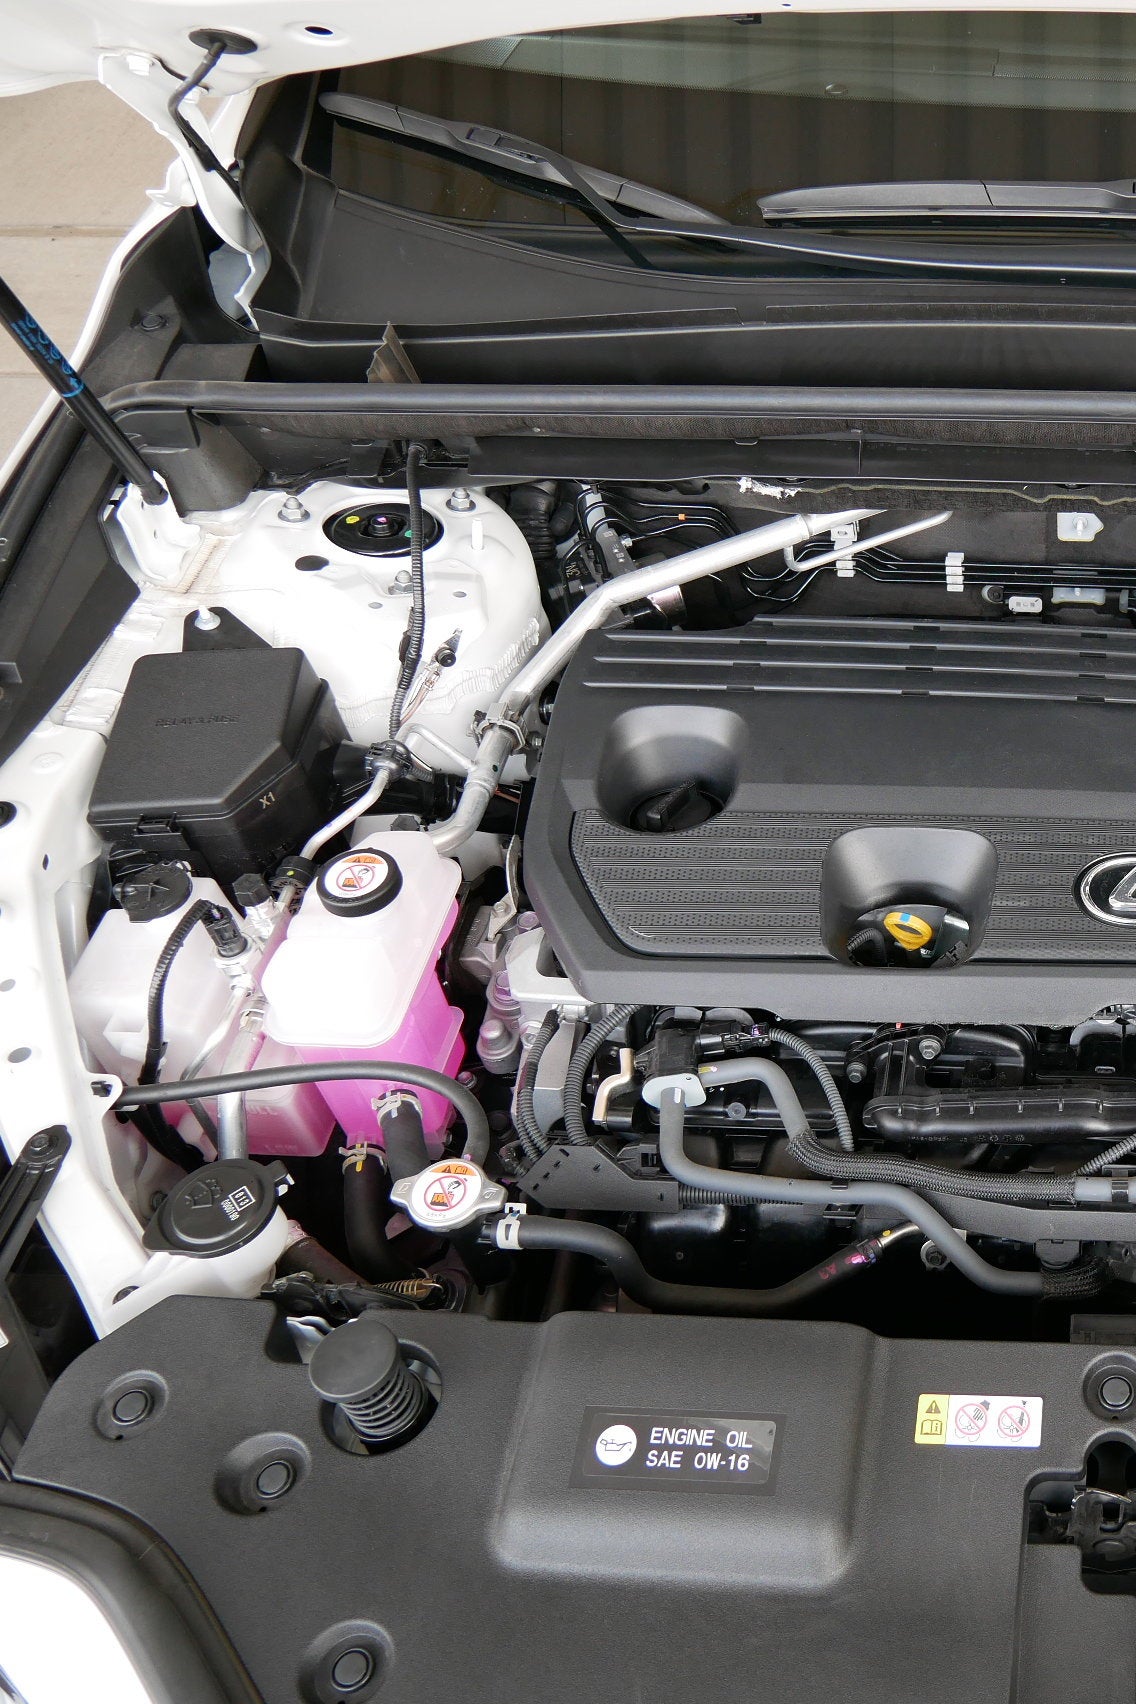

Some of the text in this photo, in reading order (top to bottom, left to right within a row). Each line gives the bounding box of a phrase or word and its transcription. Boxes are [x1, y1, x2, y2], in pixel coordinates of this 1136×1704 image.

[258, 791, 276, 810] X1
[649, 1427, 753, 1448] ENGINE OIL
[645, 1449, 751, 1472] SAE 0W-16
